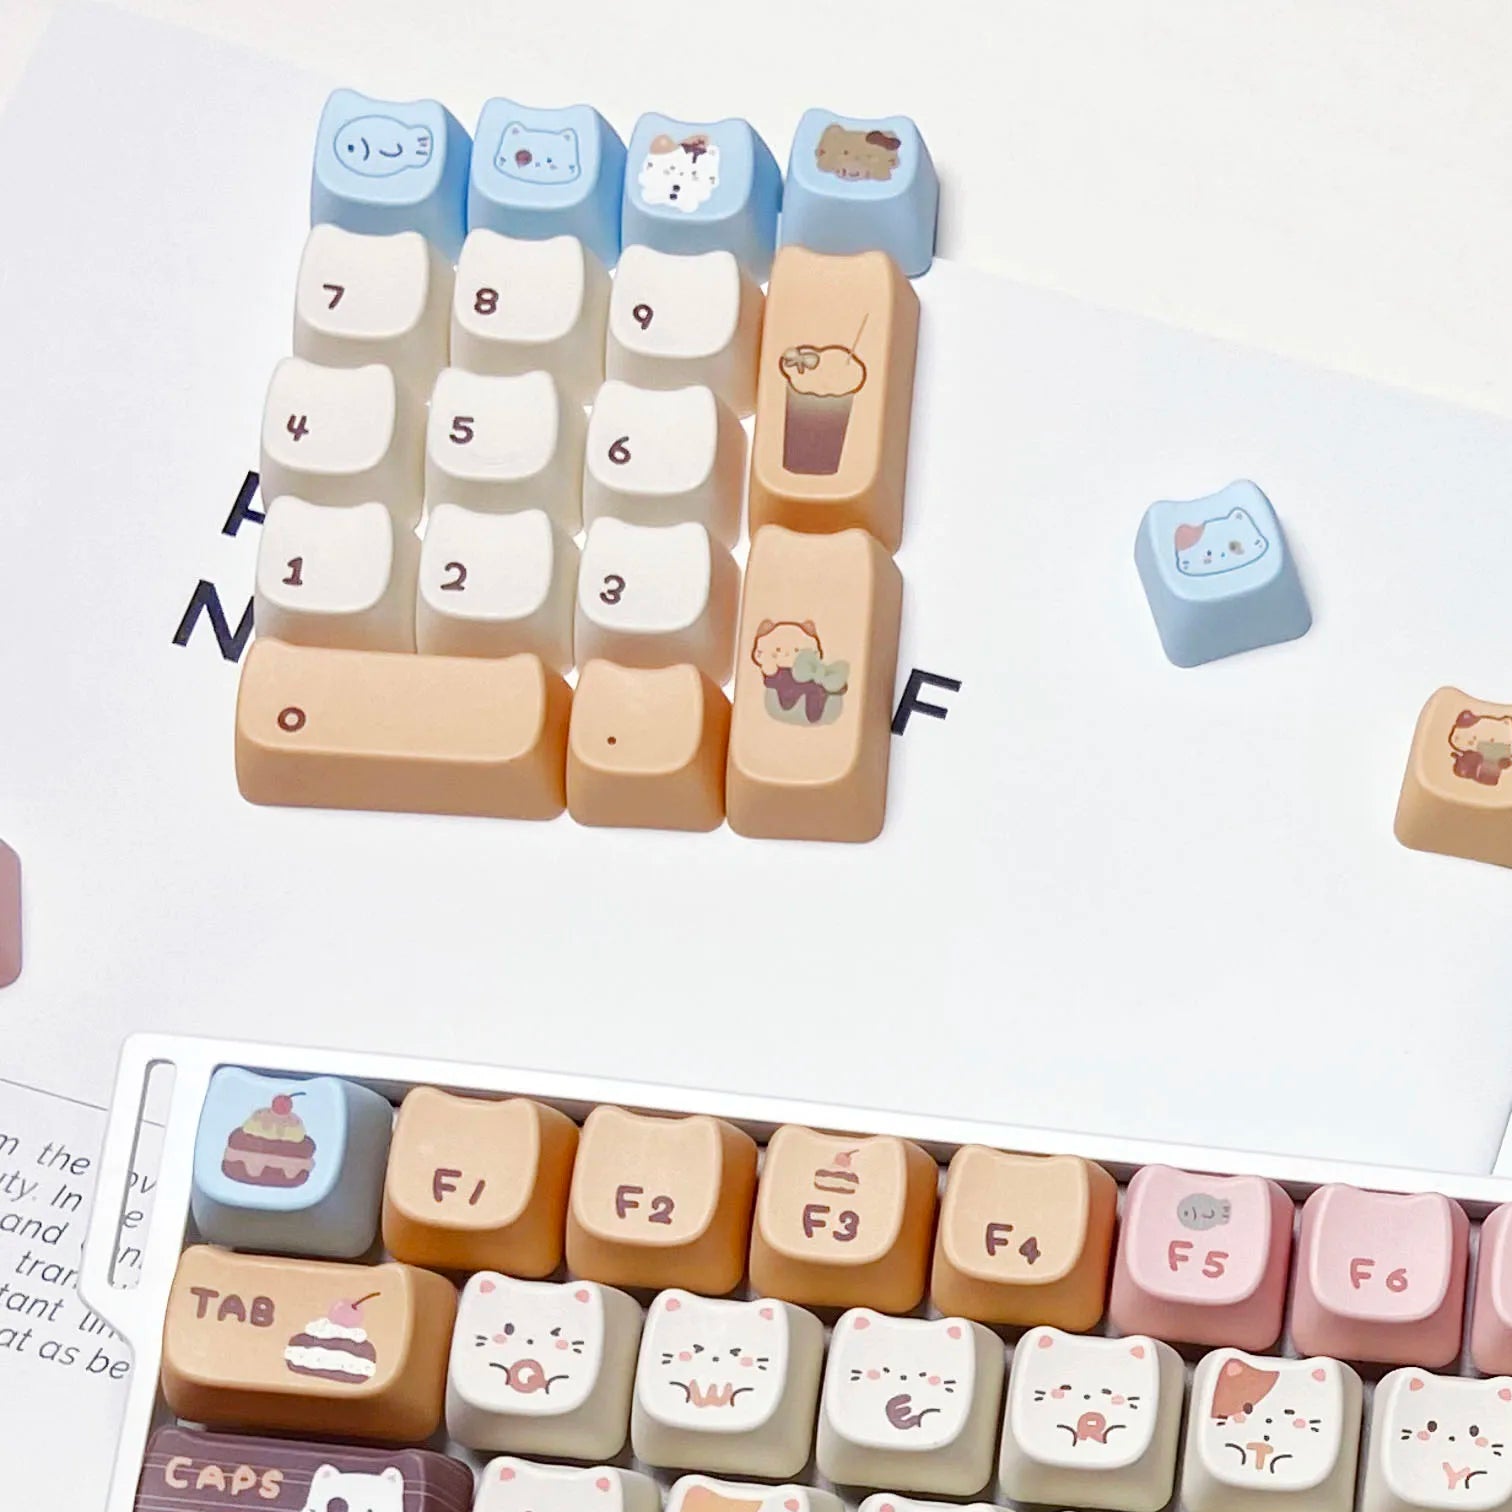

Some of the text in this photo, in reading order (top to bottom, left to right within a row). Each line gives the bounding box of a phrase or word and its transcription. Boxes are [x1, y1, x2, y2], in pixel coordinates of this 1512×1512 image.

[321, 283, 346, 310] 7
[472, 286, 499, 316] 8
[632, 303, 655, 331] 9
[285, 413, 310, 441] 4
[447, 416, 475, 445] 5
[607, 435, 631, 465] 6
[282, 556, 303, 586] 1
[440, 561, 467, 591] 2
[599, 574, 626, 605] 3
[37, 1141, 90, 1175] the
[51, 1184, 83, 1212] In
[432, 1168, 485, 1205] F1
[615, 1185, 675, 1224] F2
[0, 1213, 69, 1245] and
[803, 1204, 860, 1241] F3
[985, 1222, 1041, 1265] F4
[1168, 1241, 1230, 1279] F5
[1350, 1258, 1407, 1293] F6
[189, 1287, 276, 1328] TAB
[38, 1340, 80, 1366] as
[85, 1348, 130, 1379] be
[508, 1359, 546, 1394] Q
[689, 1379, 733, 1407] W
[1077, 1411, 1108, 1444] R
[1246, 1442, 1275, 1470] T
[164, 1457, 285, 1499] CAPS
[1442, 1462, 1471, 1490] Y
